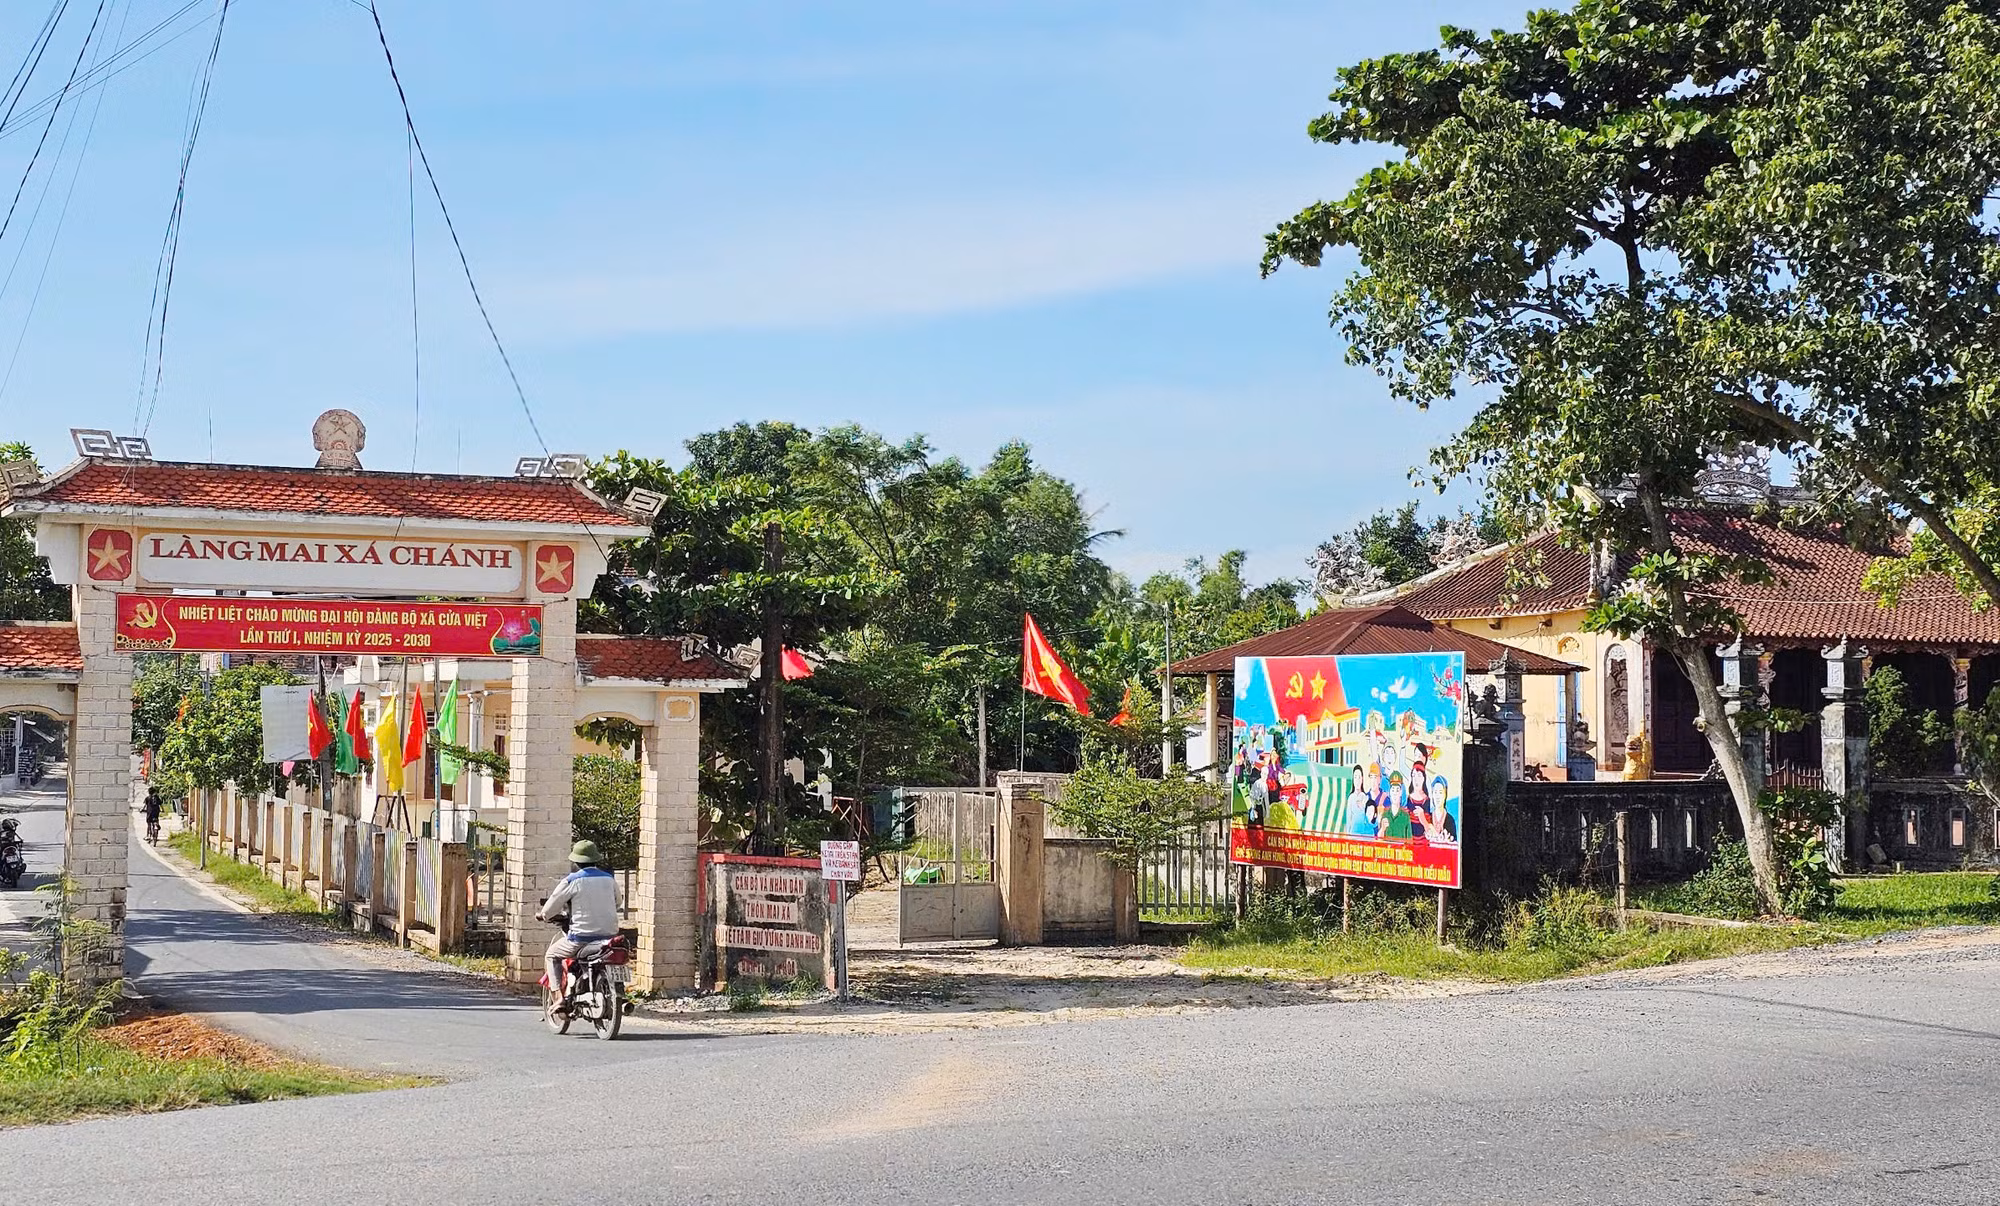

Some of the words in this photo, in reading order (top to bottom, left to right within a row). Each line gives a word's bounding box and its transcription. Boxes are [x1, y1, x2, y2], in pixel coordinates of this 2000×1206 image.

[150, 535, 253, 561] LÀNG
[257, 541, 328, 563] MAI
[334, 541, 383, 565] XÁ
[389, 544, 512, 568] CHÁNH
[179, 604, 214, 623] NHIỆT
[218, 605, 242, 623] LIỆT
[246, 606, 278, 622] CHÀO
[282, 607, 317, 623] MỪNG
[320, 610, 340, 626] ĐẠI
[344, 608, 363, 626] HỘI
[366, 607, 398, 625] ĐẢNG
[402, 610, 416, 628] BỘ
[420, 610, 436, 626] XÃ
[439, 609, 461, 626] CỬA
[464, 612, 487, 629] VIỆT
[240, 626, 263, 644] LẦN
[267, 628, 291, 644] THỨ
[304, 629, 342, 647] NHIỆM
[346, 630, 361, 646] KỲ
[364, 632, 392, 646] 2025
[403, 634, 431, 647] 2030
[767, 904, 779, 919] MAI
[786, 933, 803, 948] DANH
